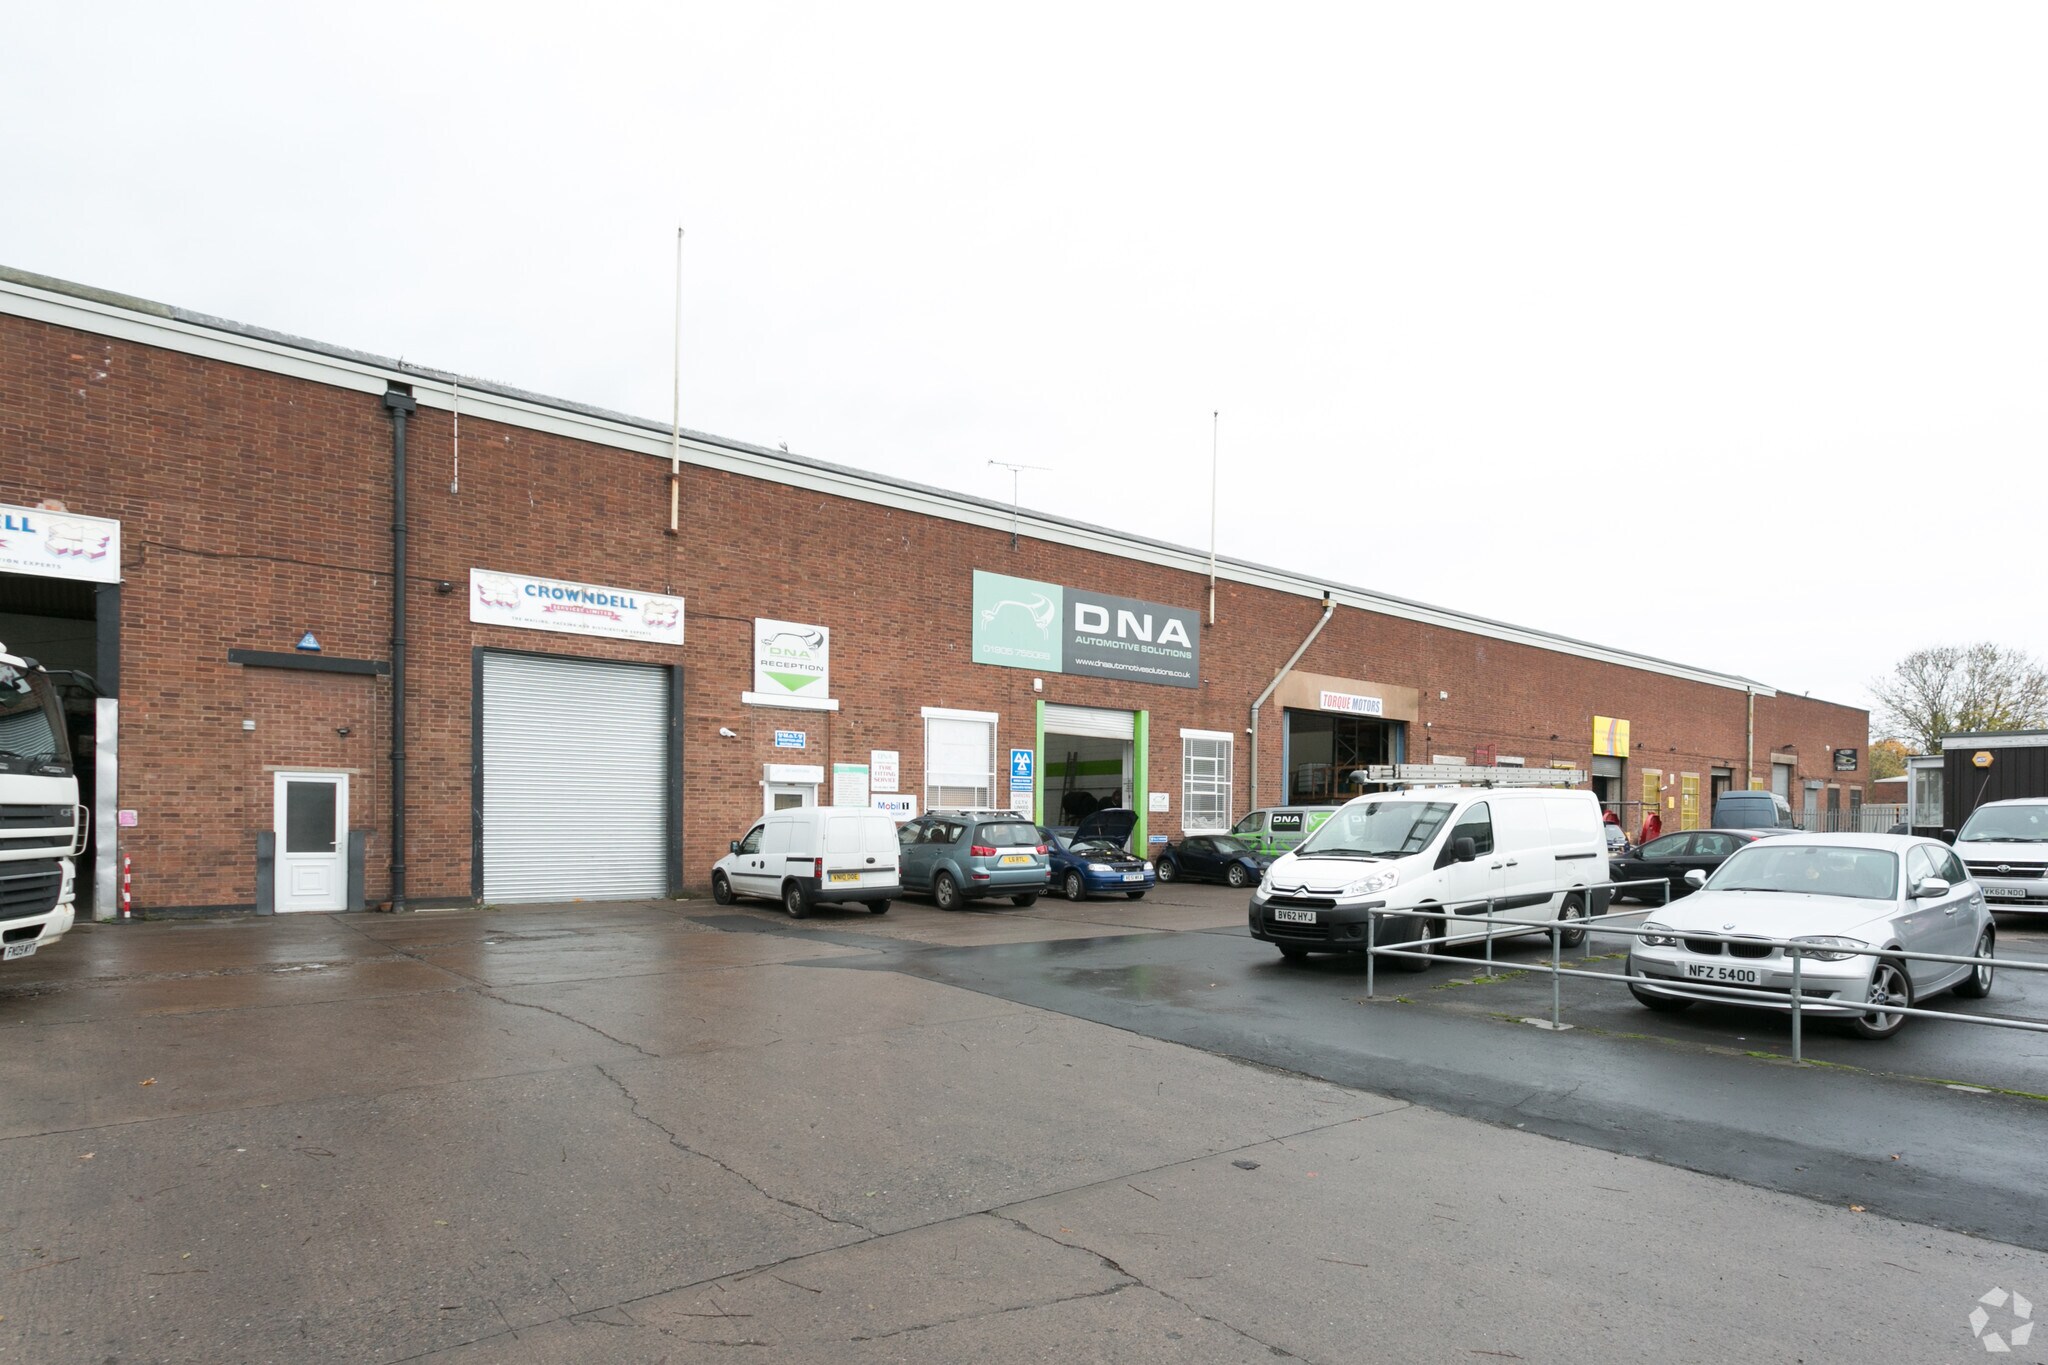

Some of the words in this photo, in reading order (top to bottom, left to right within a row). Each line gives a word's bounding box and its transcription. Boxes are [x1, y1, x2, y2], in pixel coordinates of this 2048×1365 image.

[0, 514, 37, 534] LL
[24, 560, 62, 570] EXPERTS
[524, 584, 638, 610] CROWNDELL
[553, 604, 585, 613] SERVICES
[585, 608, 613, 616] LIMITED
[1074, 602, 1192, 649] DNA
[769, 647, 811, 658] DNA
[1075, 635, 1140, 652] AUTOMOTIVE
[1141, 645, 1192, 659] SOLUTIONS
[760, 660, 824, 672] RECEPTION
[1075, 658, 1191, 679] www.dnaautomotivesolutions.co.uk
[1323, 694, 1351, 709] TORQUE
[1352, 697, 1381, 713] MOTORS
[877, 801, 901, 810] Mobil
[1273, 815, 1300, 823] DNA
[1984, 888, 2006, 896] VK60
[1278, 910, 1297, 920] BV62
[1298, 912, 1313, 921] HYJ
[1689, 964, 1714, 978] NFZ
[1719, 968, 1756, 982] 5400
